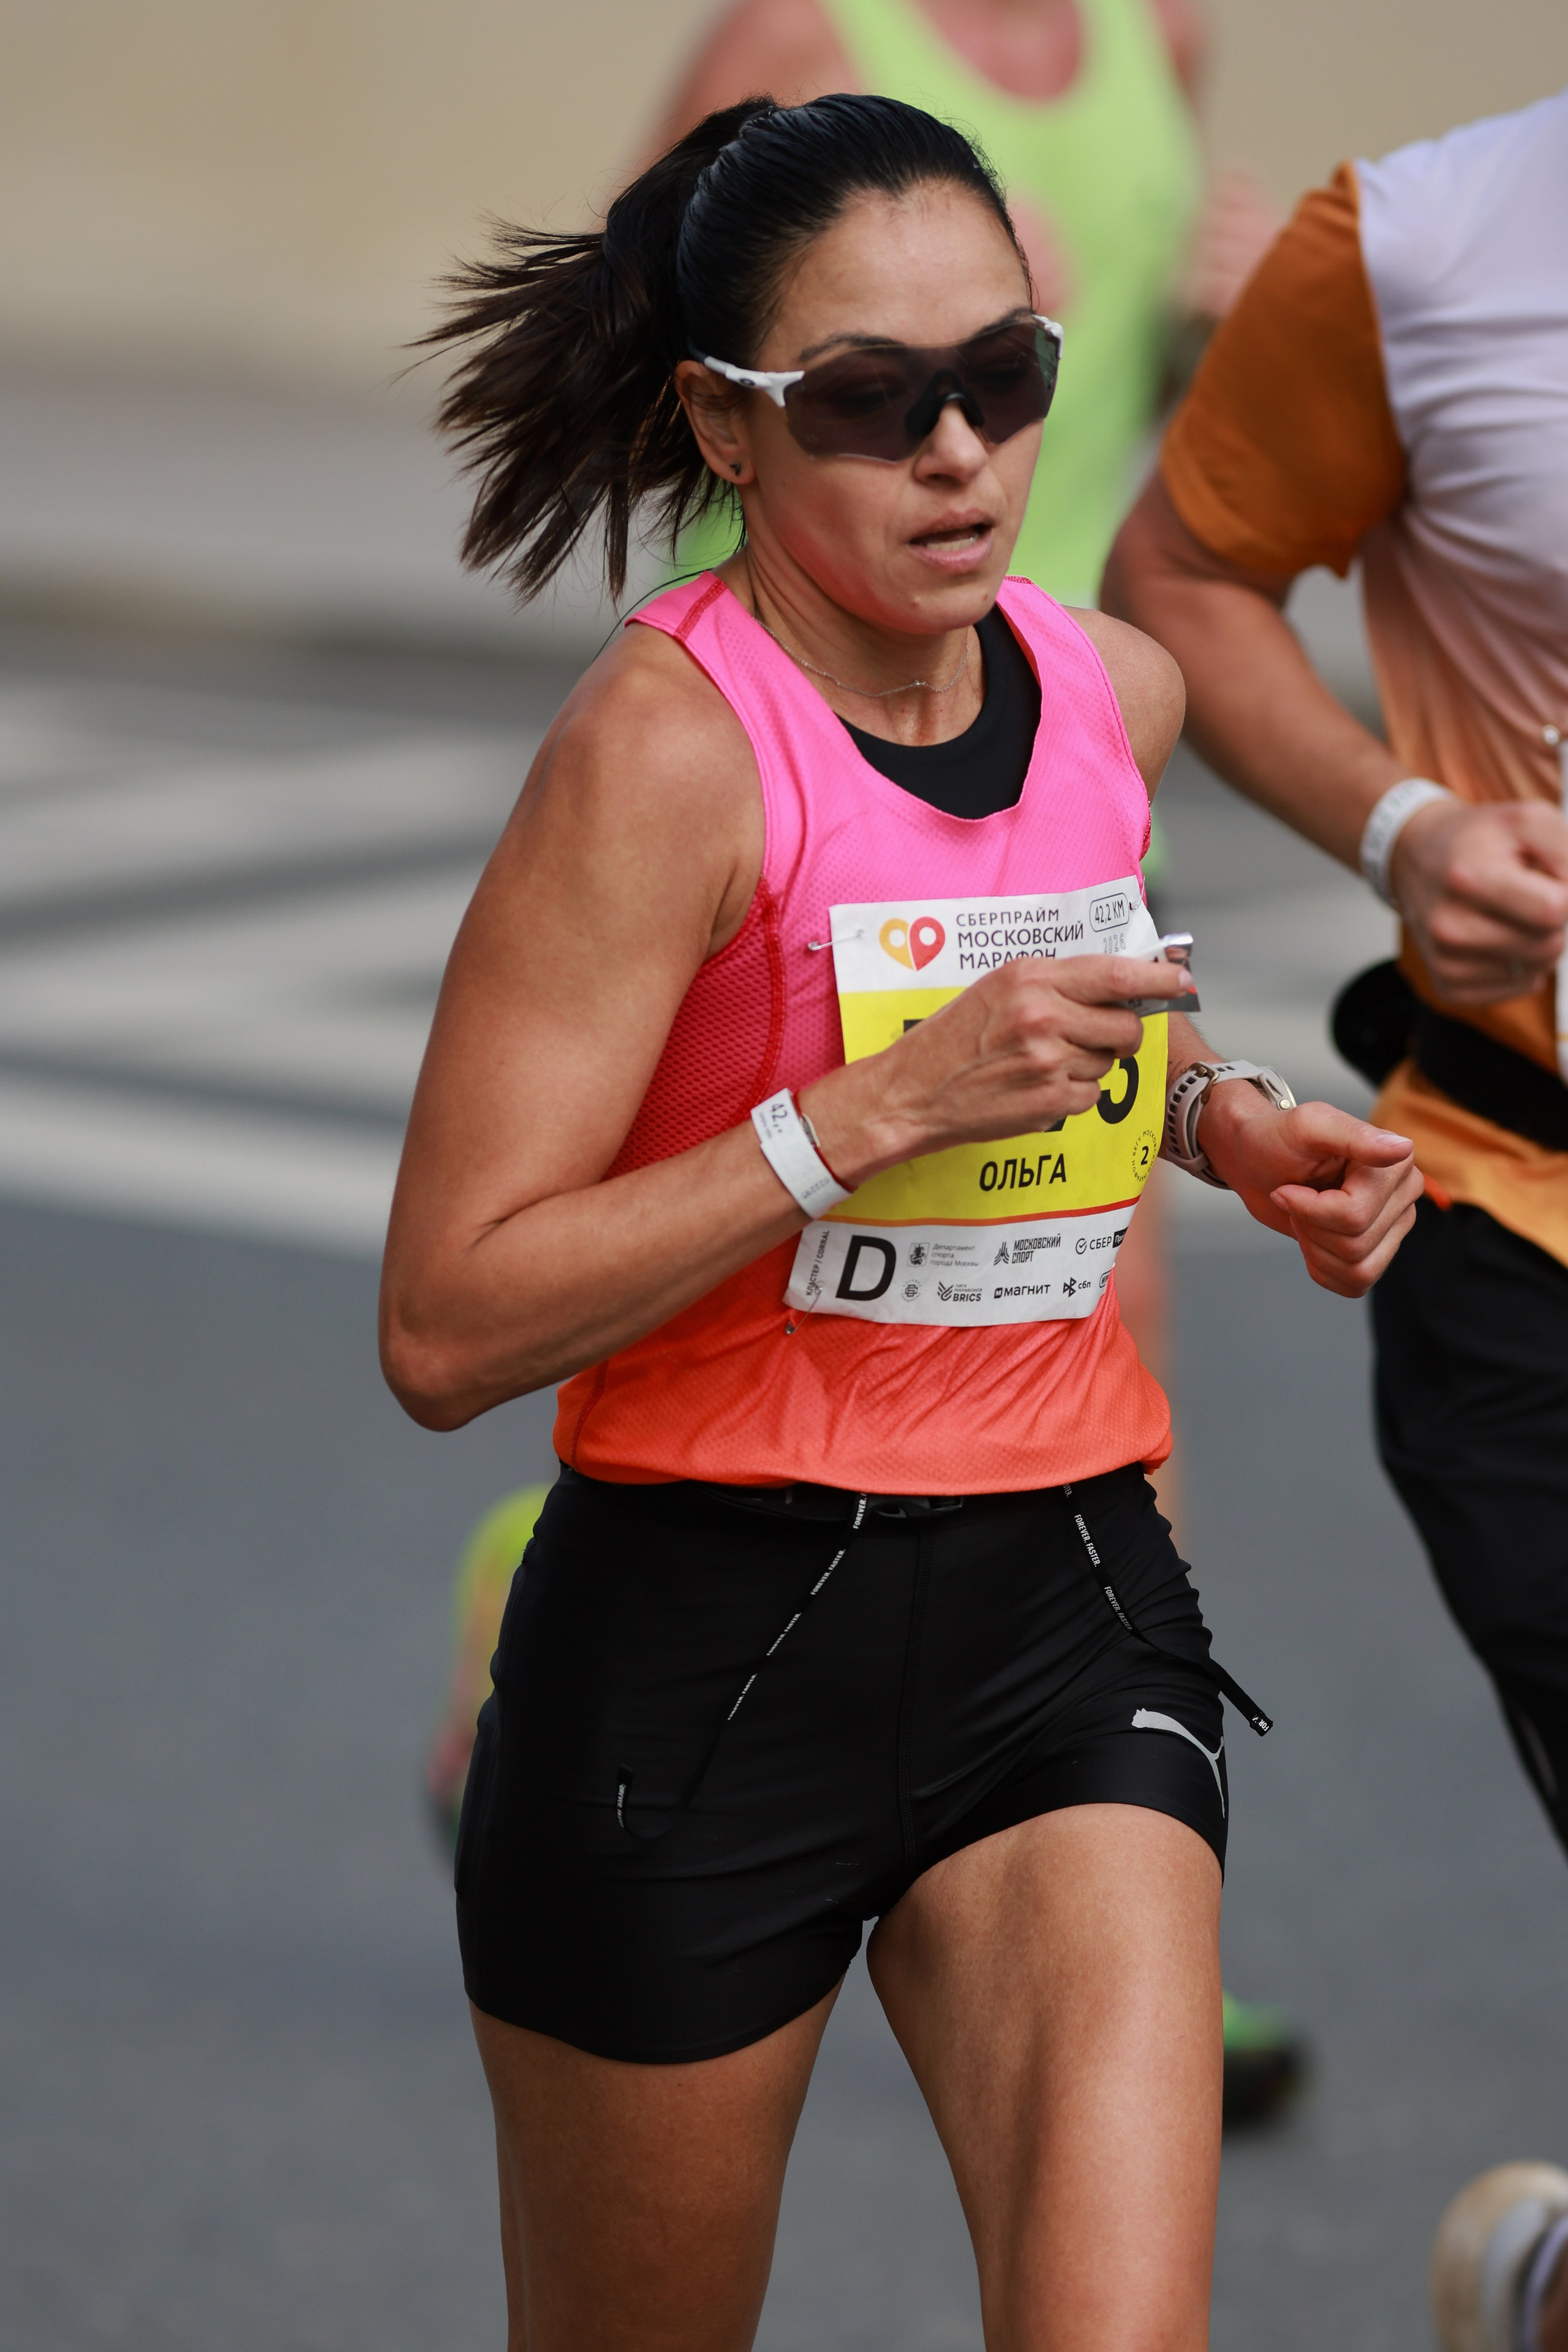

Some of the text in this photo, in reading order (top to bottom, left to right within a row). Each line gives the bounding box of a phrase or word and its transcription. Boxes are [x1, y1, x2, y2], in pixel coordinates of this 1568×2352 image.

[956, 907, 1059, 927] СБЕРПРАЙМ
[1095, 904, 1112, 925] 42,2
[958, 920, 1084, 948] МОСКОВСКИЙ
[1103, 933, 1126, 955] 2026
[1140, 1145, 1149, 1166] 2
[979, 1153, 1067, 1192] ОЛЬГА
[932, 1243, 976, 1251] Департамент
[1013, 1233, 1061, 1251] МОСКОВСКИЙ
[1089, 1235, 1112, 1250] СБЕР
[1011, 1250, 1035, 1264] СПОРТ
[835, 1235, 897, 1302] D
[952, 1293, 982, 1302] BRICS
[852, 1498, 867, 1529] FOREVER.
[1074, 1513, 1101, 1567] FOREVER. FASTER.
[810, 1548, 846, 1596] FOREVER. FASTER.
[1104, 1585, 1133, 1632] FOREVER. FASTER.
